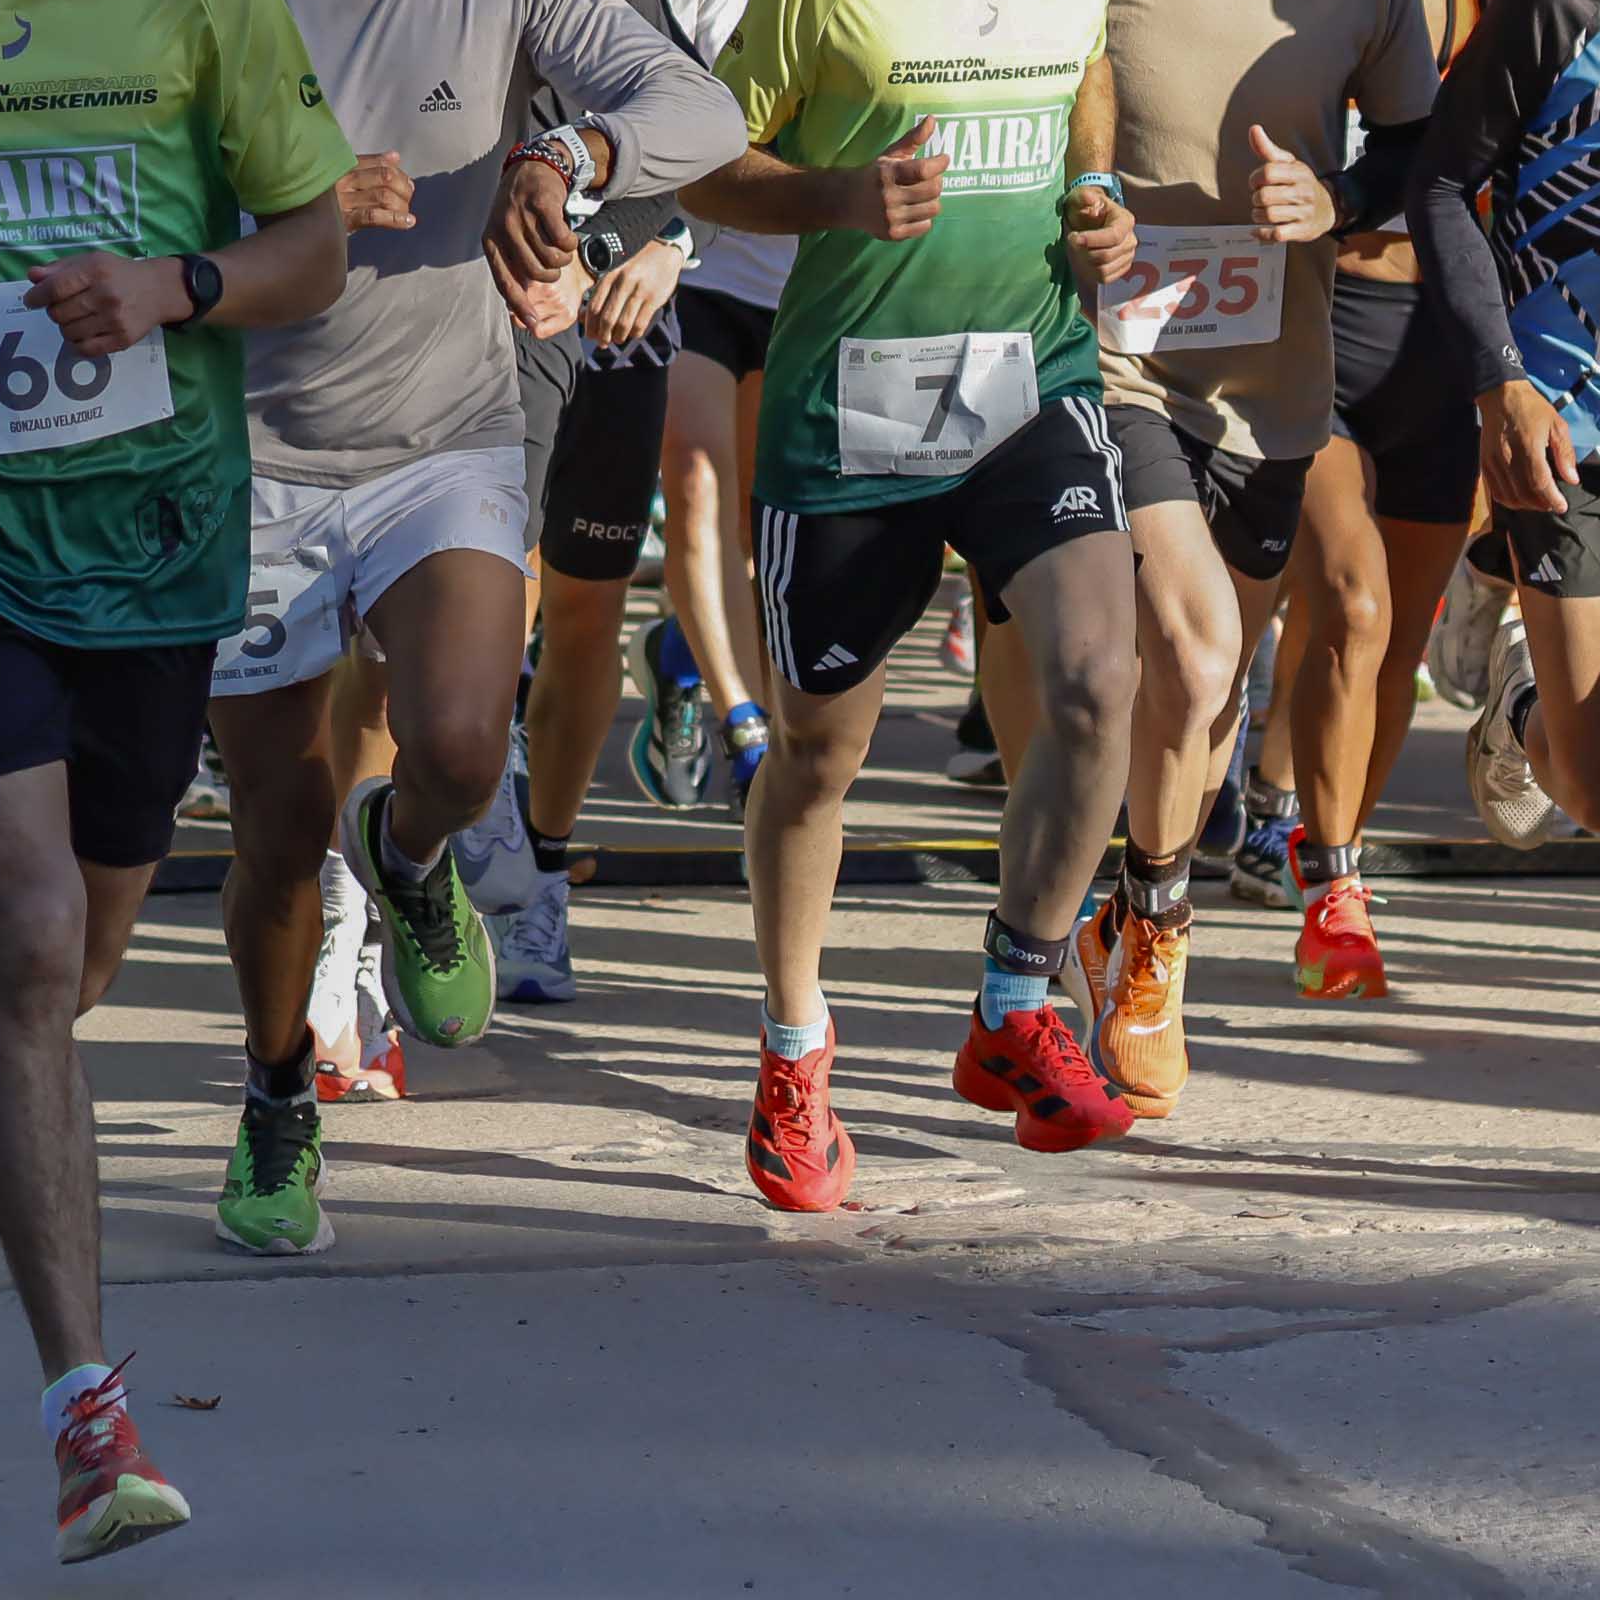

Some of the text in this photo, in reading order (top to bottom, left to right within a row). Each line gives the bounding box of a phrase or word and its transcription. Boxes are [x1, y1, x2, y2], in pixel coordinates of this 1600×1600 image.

[887, 60, 1080, 85] CAWILLIAMSKEMMIS
[419, 100, 463, 113] adidas
[921, 113, 1053, 171] MAIRA
[1117, 256, 1260, 321] 235
[10, 406, 104, 433] GONZALO VELAZQUEZ
[915, 374, 958, 443] 7
[905, 449, 974, 461] MICAEL POLIDORO
